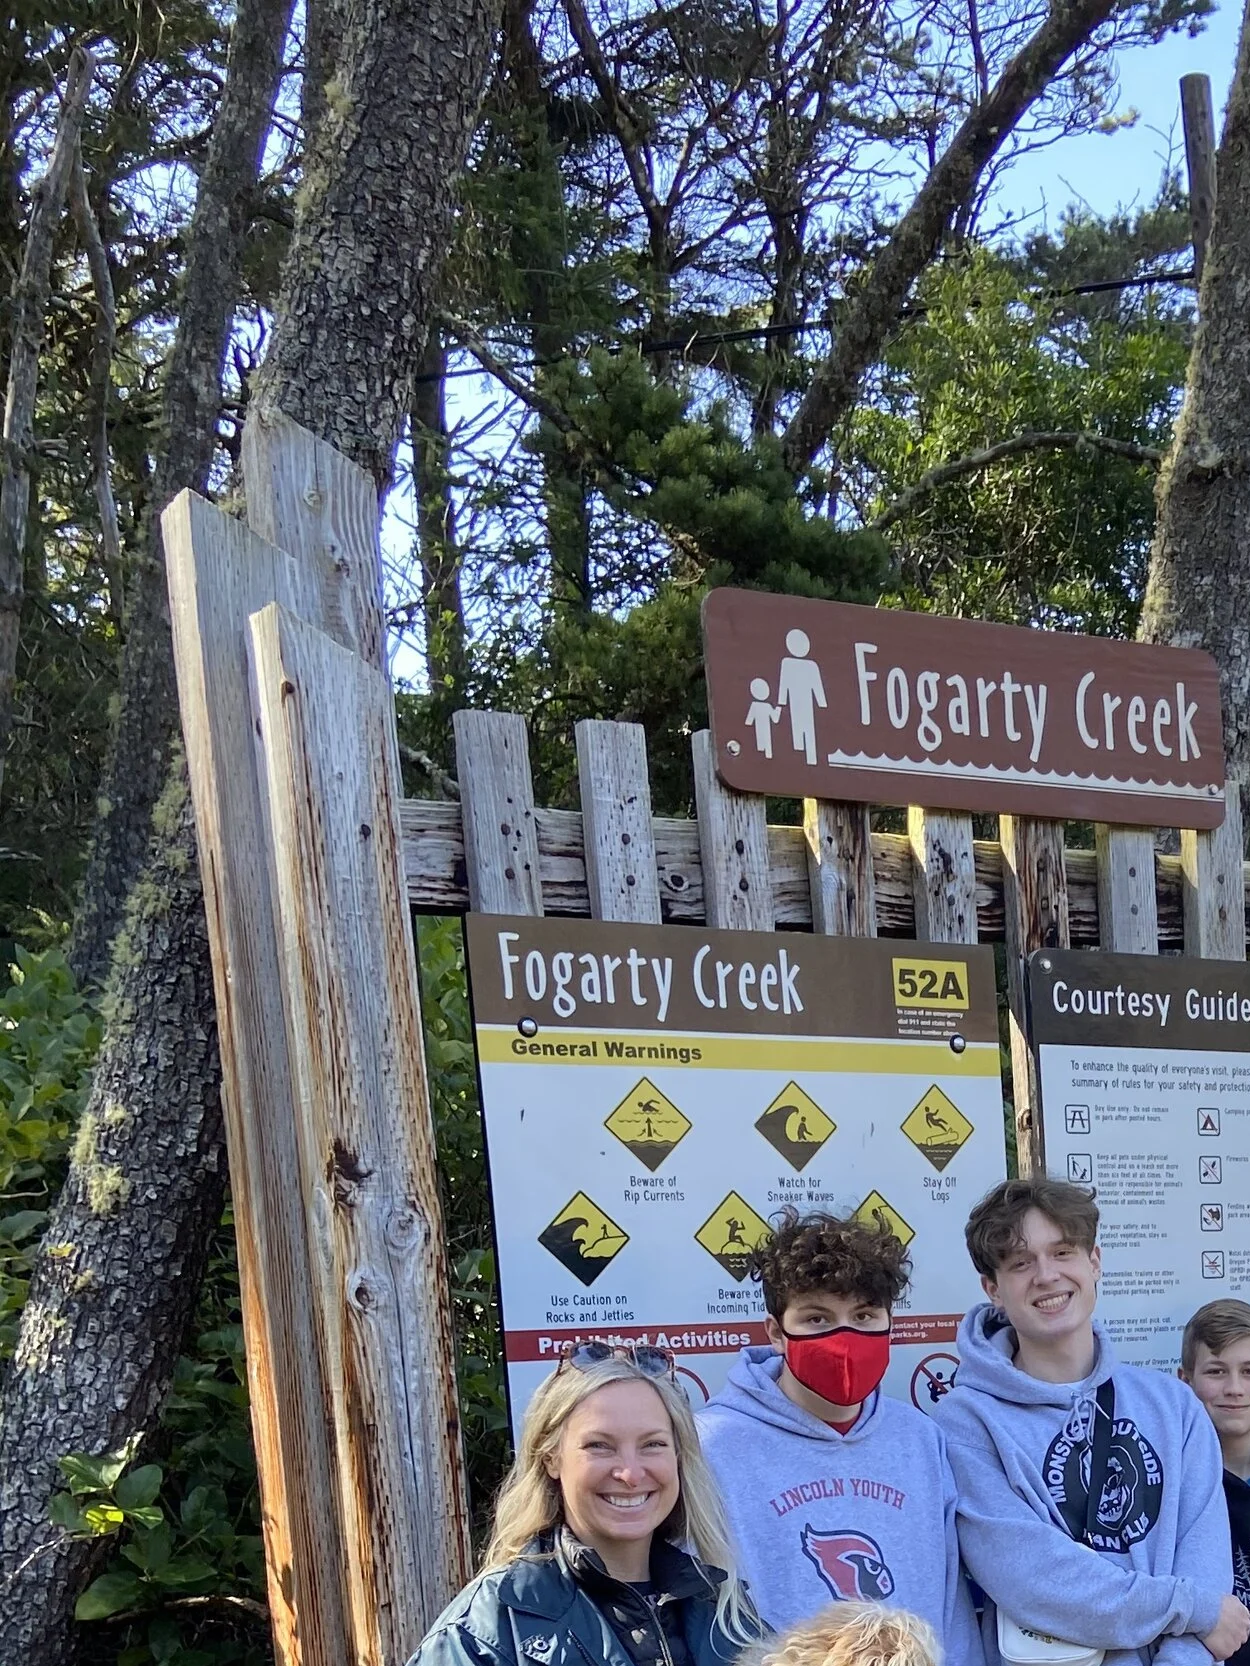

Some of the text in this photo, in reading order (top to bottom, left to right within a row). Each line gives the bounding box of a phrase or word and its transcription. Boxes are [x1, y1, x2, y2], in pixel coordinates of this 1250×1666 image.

[854, 642, 1201, 763] Fogarty Creek
[498, 932, 804, 1022] Fogarty Creek
[899, 969, 964, 1000] 52A
[1053, 980, 1170, 1027] Courtesy
[511, 1039, 702, 1063] General Warnings
[1070, 1060, 1079, 1070] To
[1082, 1062, 1114, 1072] enhance
[1117, 1062, 1128, 1072] the
[1132, 1063, 1158, 1075] quality
[1162, 1064, 1168, 1074] of
[1172, 1066, 1210, 1076] everyone's
[1072, 1079, 1108, 1090] summary
[1112, 1078, 1118, 1088] of
[1122, 1080, 1140, 1088] rules
[1144, 1079, 1154, 1089] for
[1158, 1082, 1175, 1092] your
[1178, 1081, 1200, 1093] safety
[1204, 1082, 1217, 1091] and
[630, 1176, 676, 1187] Beware of
[778, 1176, 821, 1188] Watch for
[923, 1176, 956, 1190] Stay Off
[624, 1190, 684, 1204] Rip Currents
[768, 1190, 834, 1202] Sneaker Waves
[932, 1190, 950, 1204] Logs
[551, 1294, 628, 1306] Use Caution on
[718, 1288, 750, 1300] Beware
[707, 1302, 748, 1316] Incoming
[546, 1310, 634, 1323] Rocks and Jetties
[656, 1330, 751, 1348] Activities
[770, 1478, 906, 1517] LINCOLN YOUTH
